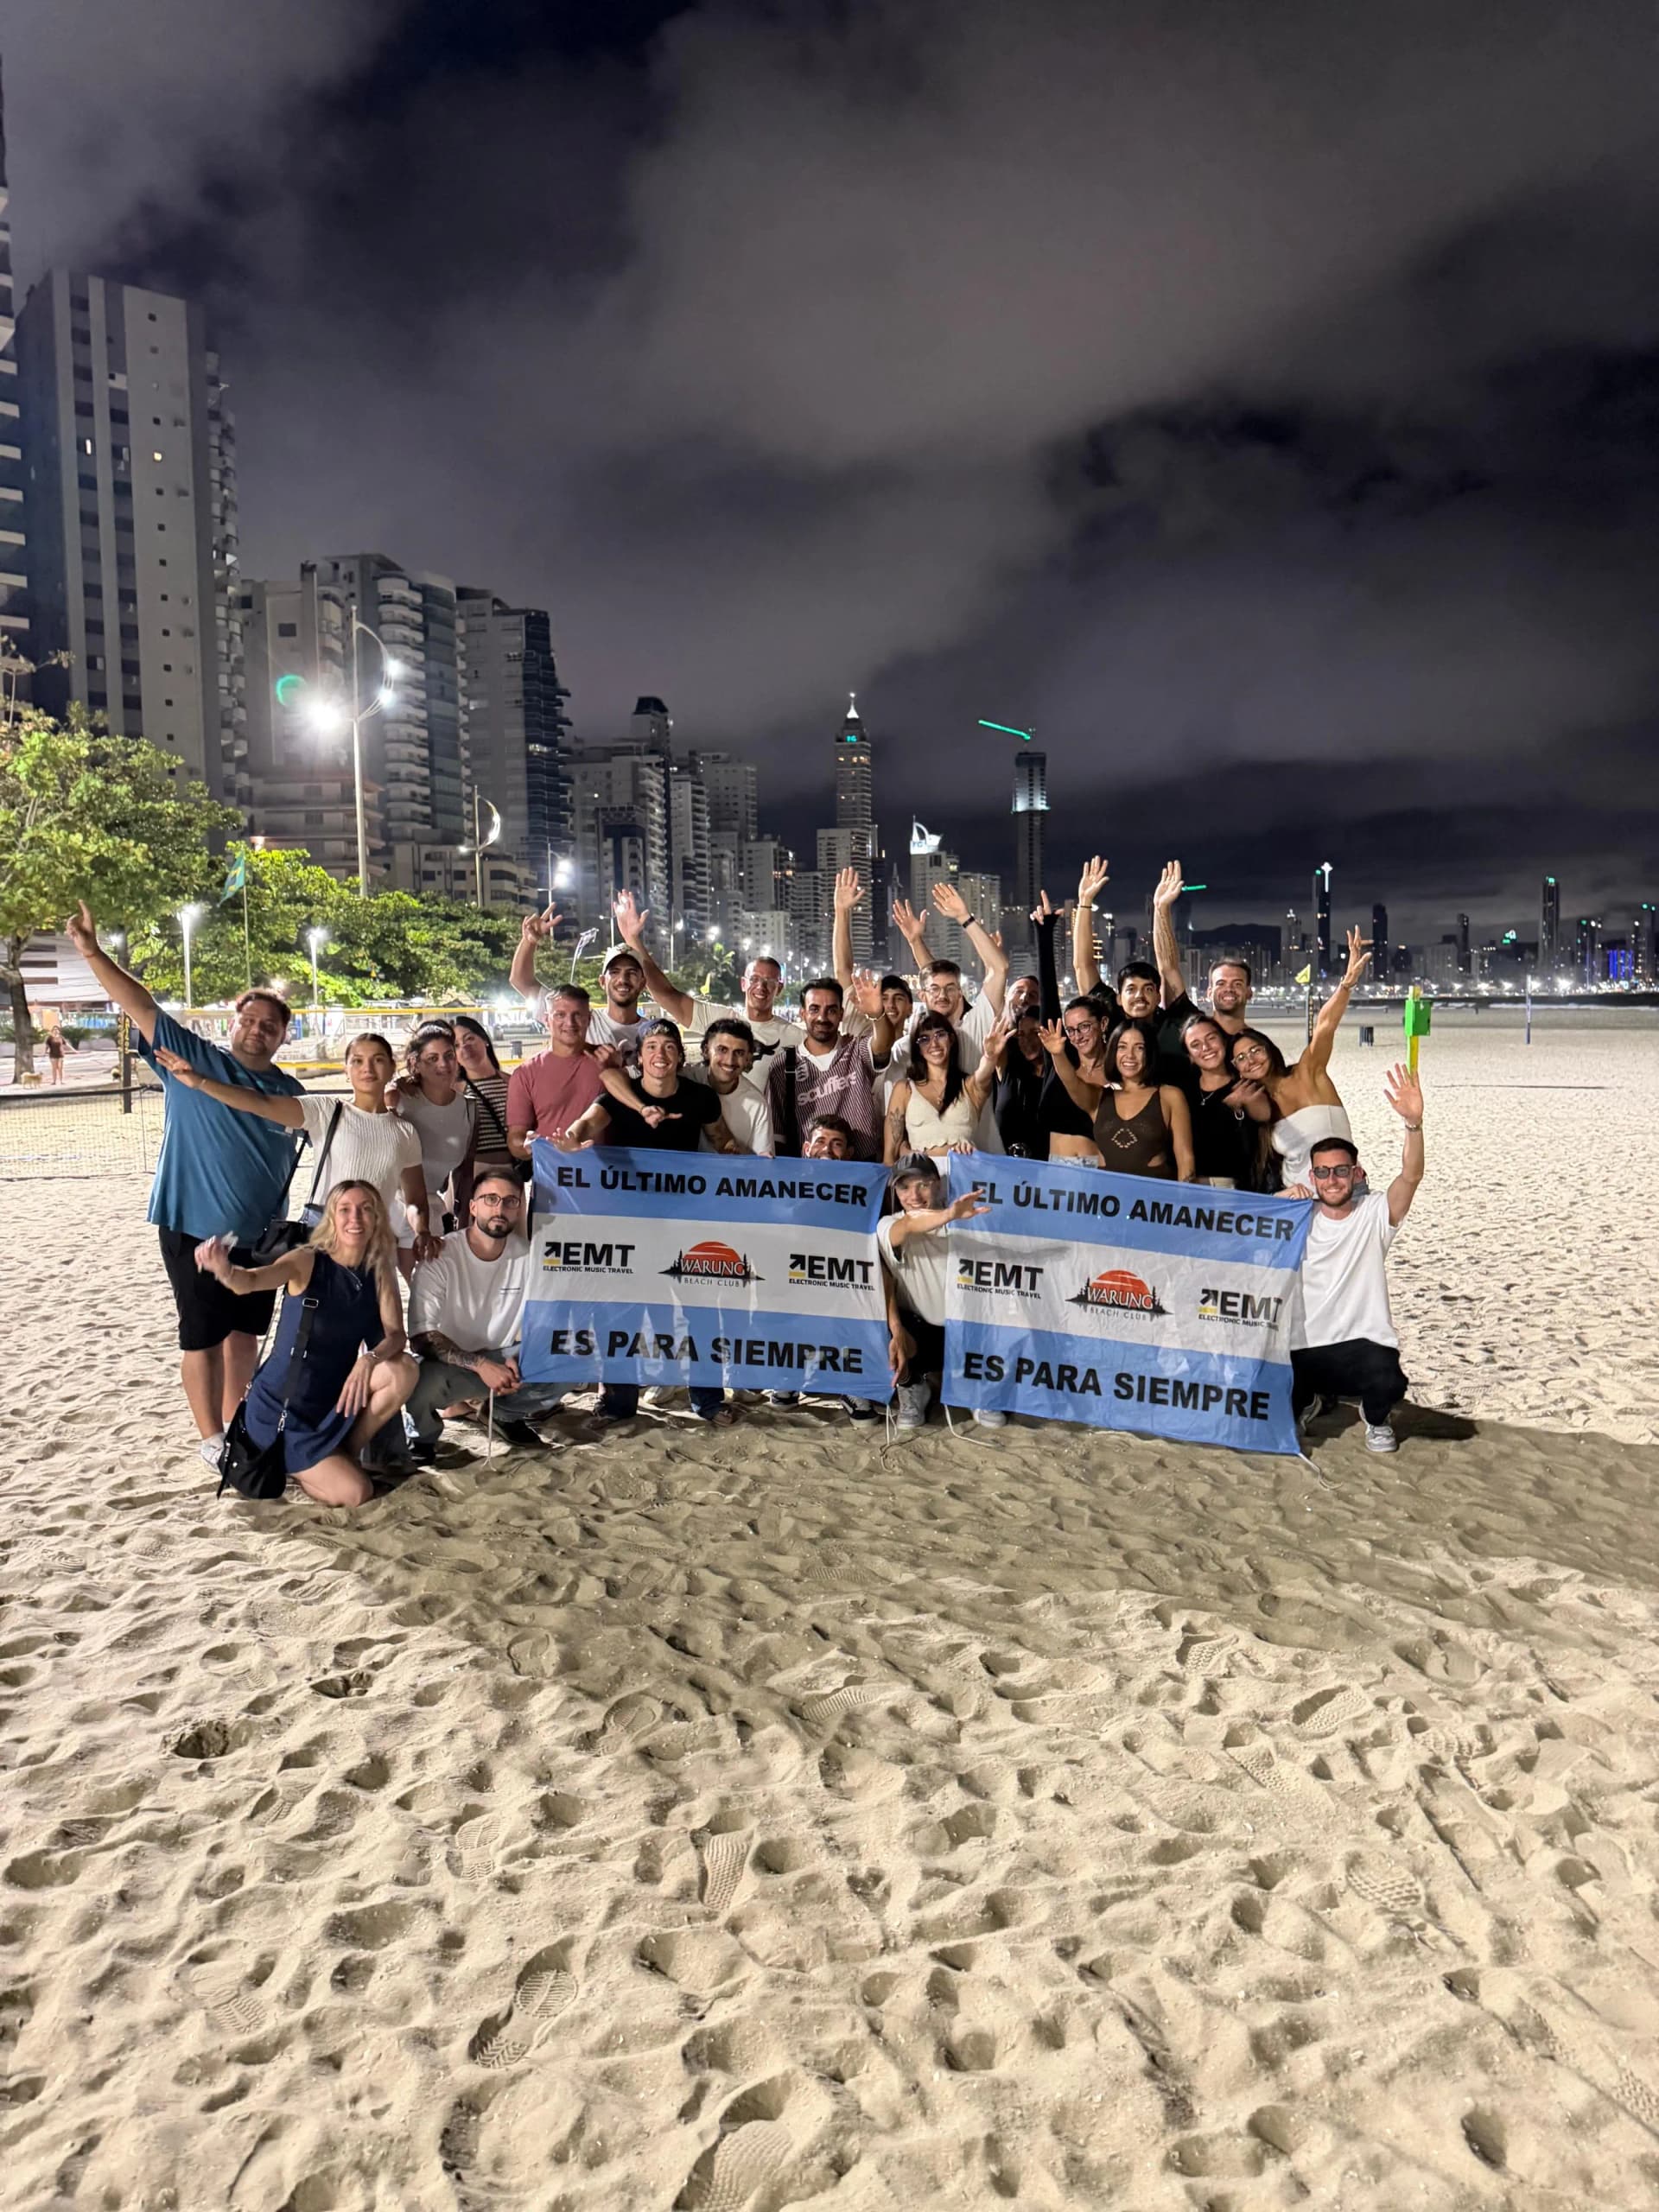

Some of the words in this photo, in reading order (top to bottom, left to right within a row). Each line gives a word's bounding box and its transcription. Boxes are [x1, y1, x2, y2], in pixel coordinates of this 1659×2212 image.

[556, 1166, 591, 1189] EL
[601, 1166, 707, 1195] ÚLTIMO
[715, 1177, 868, 1207] AMANECER
[971, 1180, 1003, 1205] EL
[1013, 1180, 1121, 1218] ÚLTIMO
[1129, 1198, 1294, 1242] AMANECER
[563, 1242, 635, 1268] EMT
[680, 1259, 746, 1276] WARUNG
[683, 1277, 713, 1286] BEACH
[717, 1279, 741, 1287] CLUB
[789, 1278, 829, 1287] ELECTRONIC
[808, 1255, 874, 1284] EMT
[975, 1261, 1044, 1292] EMT
[957, 1283, 993, 1294] ELECTRONIC
[995, 1287, 1015, 1296] MUSIC
[1017, 1290, 1042, 1300] TRAVEL
[1087, 1285, 1154, 1310] WARUNG
[1090, 1306, 1119, 1318] BEACH
[1123, 1312, 1147, 1321] CLUB
[550, 1329, 594, 1357] ES
[607, 1330, 699, 1363] PARA
[710, 1337, 863, 1375] SIEMPRE
[963, 1351, 1005, 1382] ES
[1015, 1357, 1103, 1397] PARA
[1113, 1371, 1270, 1421] SIEMPRE
